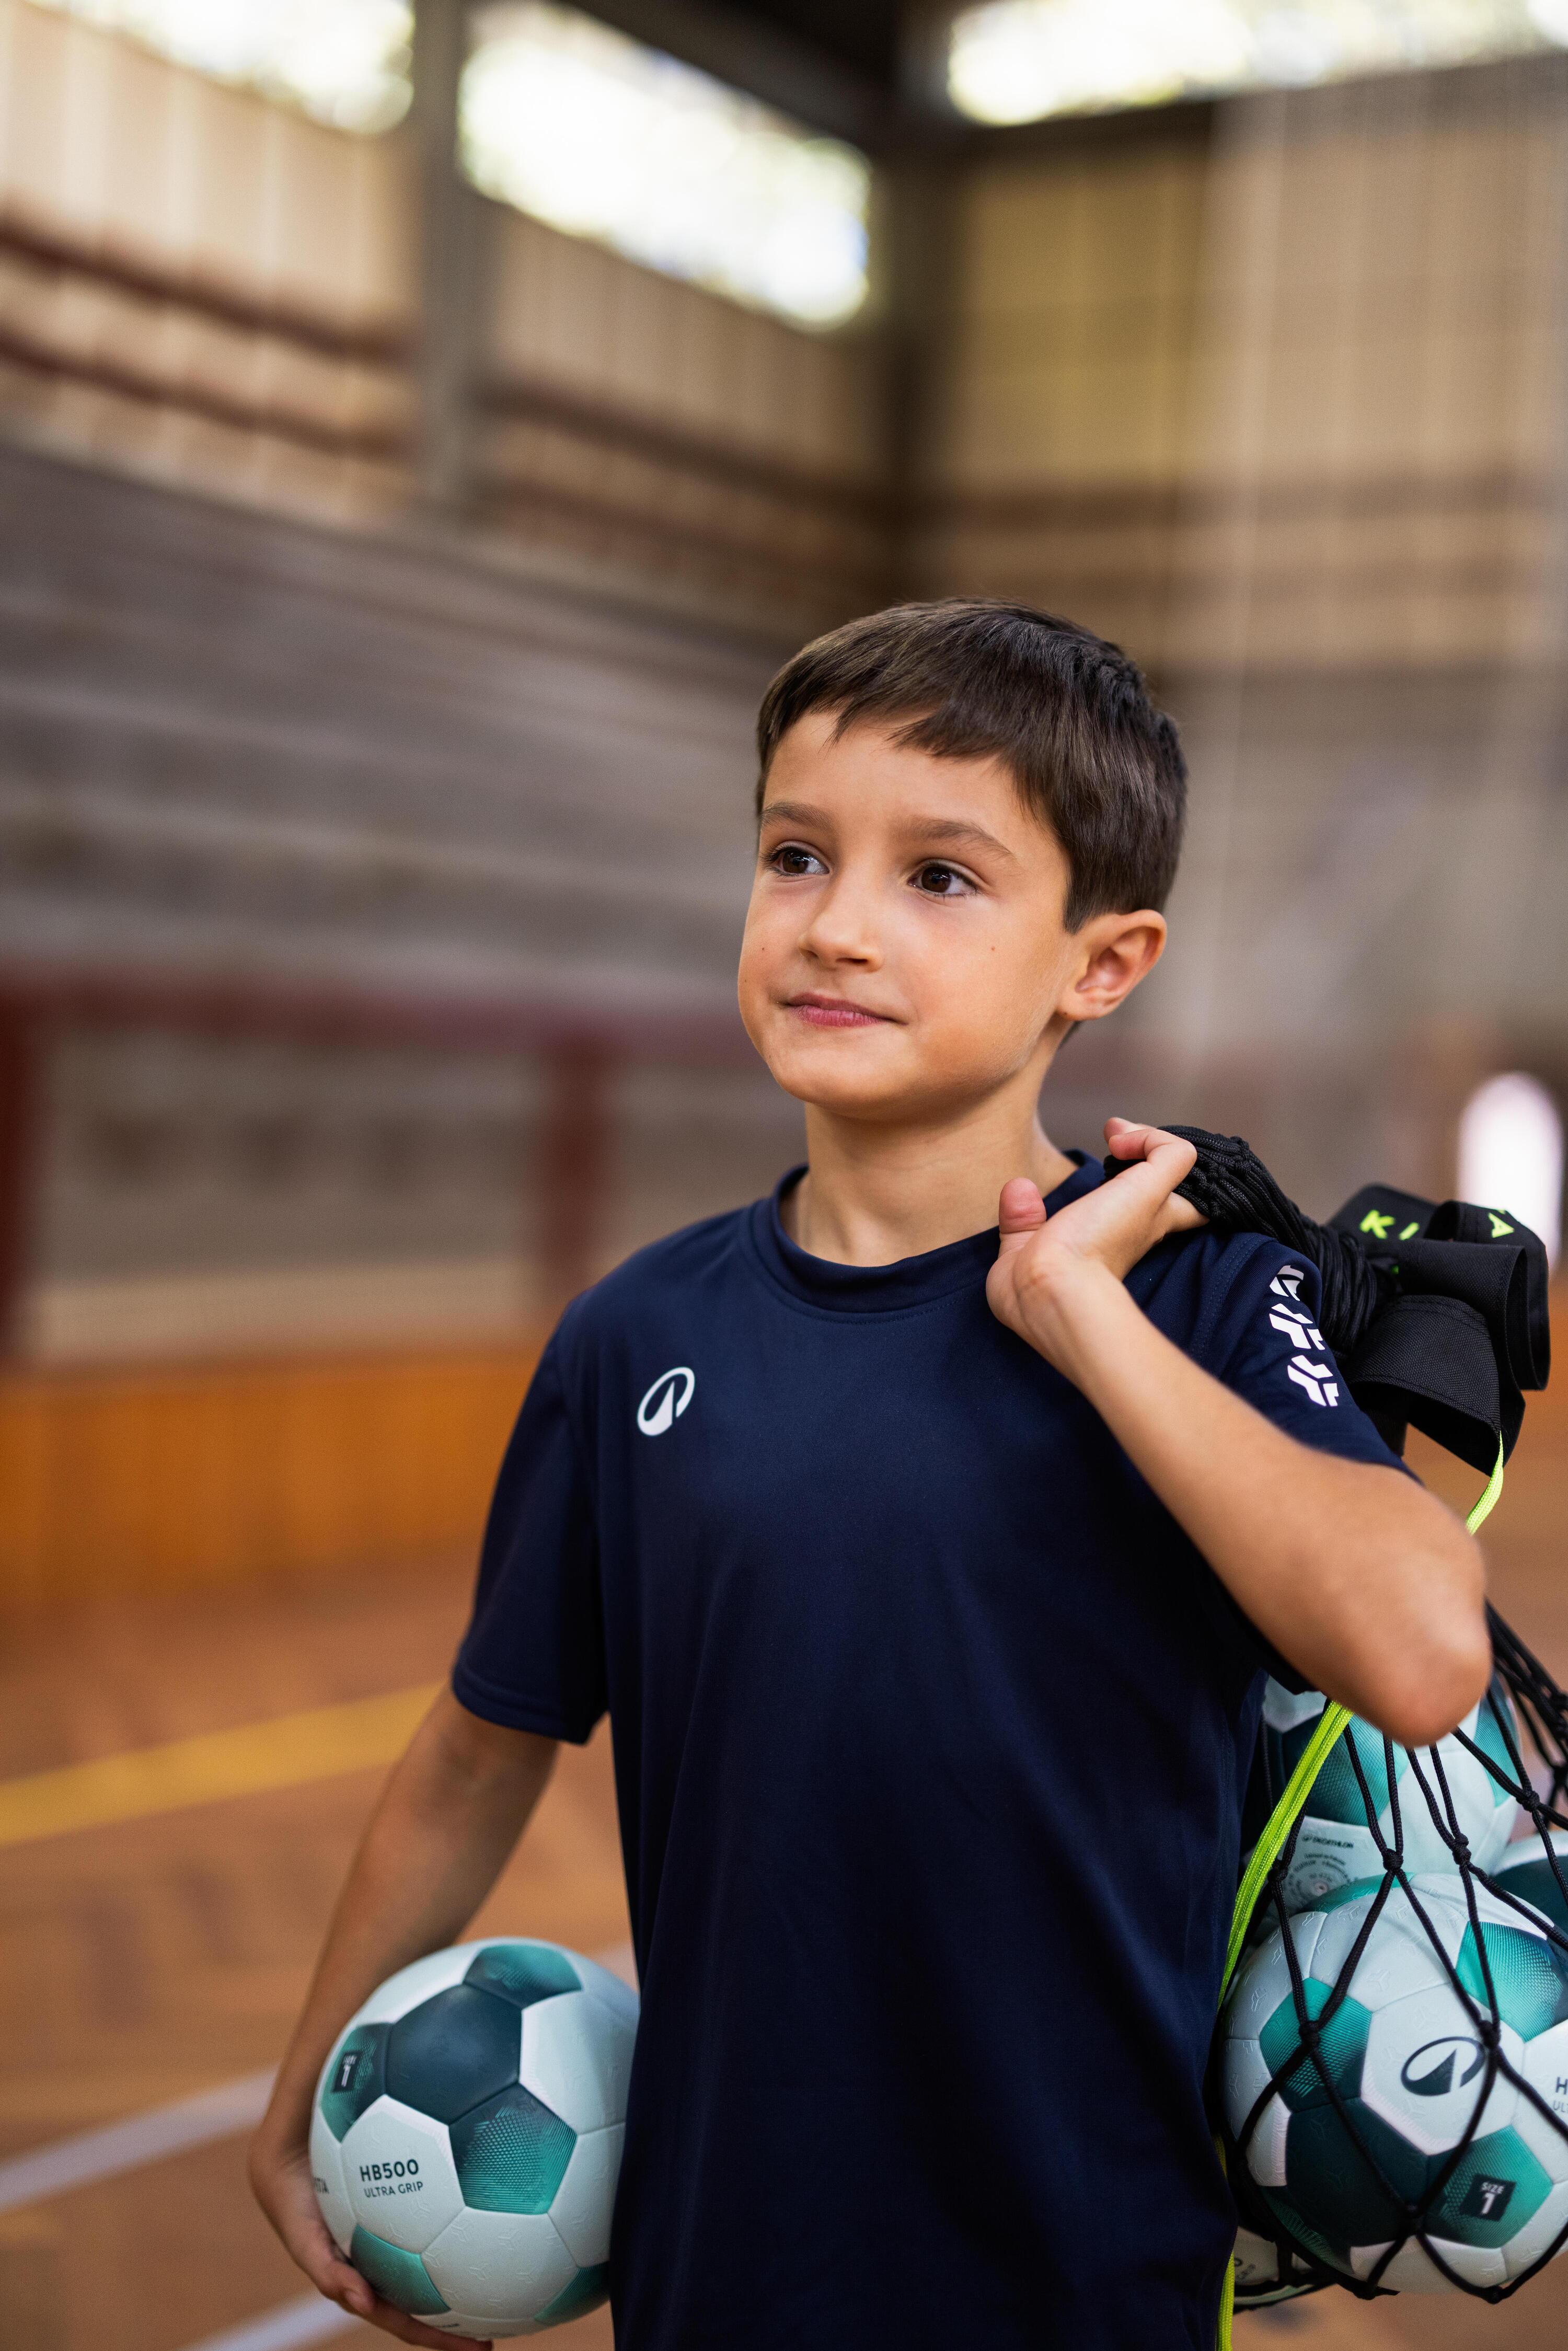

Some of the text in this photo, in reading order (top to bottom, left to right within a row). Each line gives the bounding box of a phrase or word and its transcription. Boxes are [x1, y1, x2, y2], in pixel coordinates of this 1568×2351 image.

[359, 2159, 419, 2182] HB500
[364, 2181, 423, 2198] ULTRA GRIP
[1481, 2181, 1505, 2194] SIZE
[1481, 2192, 1495, 2215] 1
